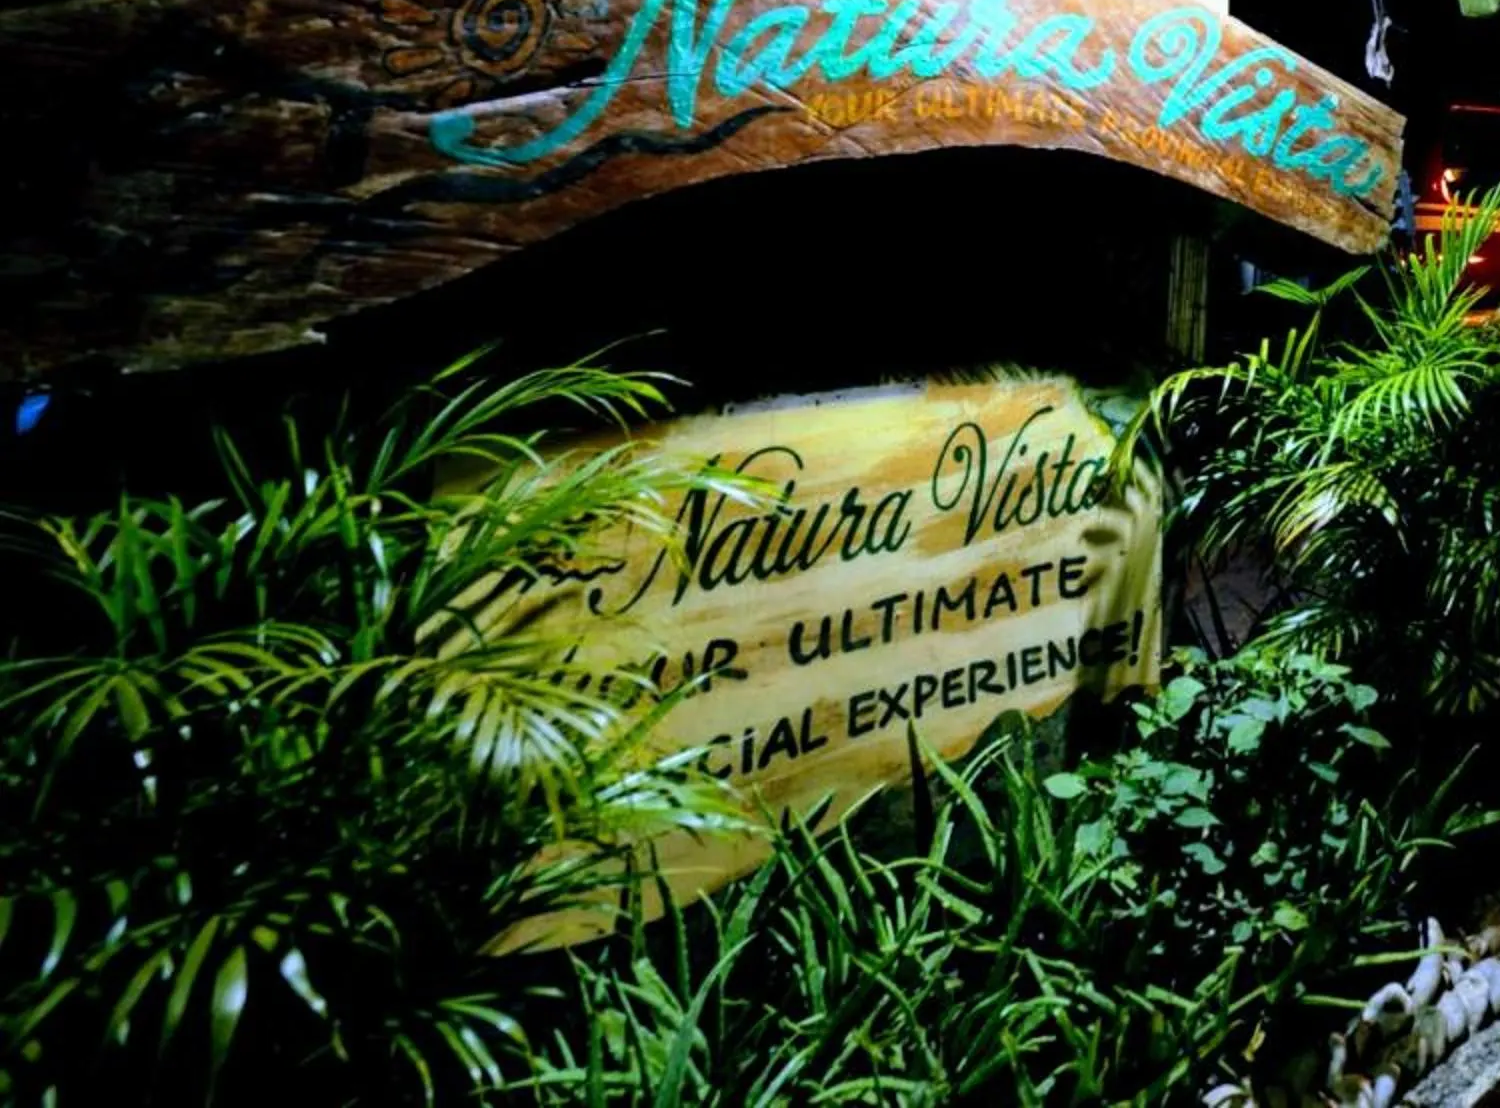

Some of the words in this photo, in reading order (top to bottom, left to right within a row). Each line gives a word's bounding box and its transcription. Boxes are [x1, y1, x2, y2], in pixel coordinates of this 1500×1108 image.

[1127, 5, 1385, 198] Vista
[587, 445, 914, 616] Natura
[932, 405, 1108, 547] Vista
[788, 555, 1088, 667] ULTIMATE
[845, 609, 1145, 739] EXPERIENCE!
